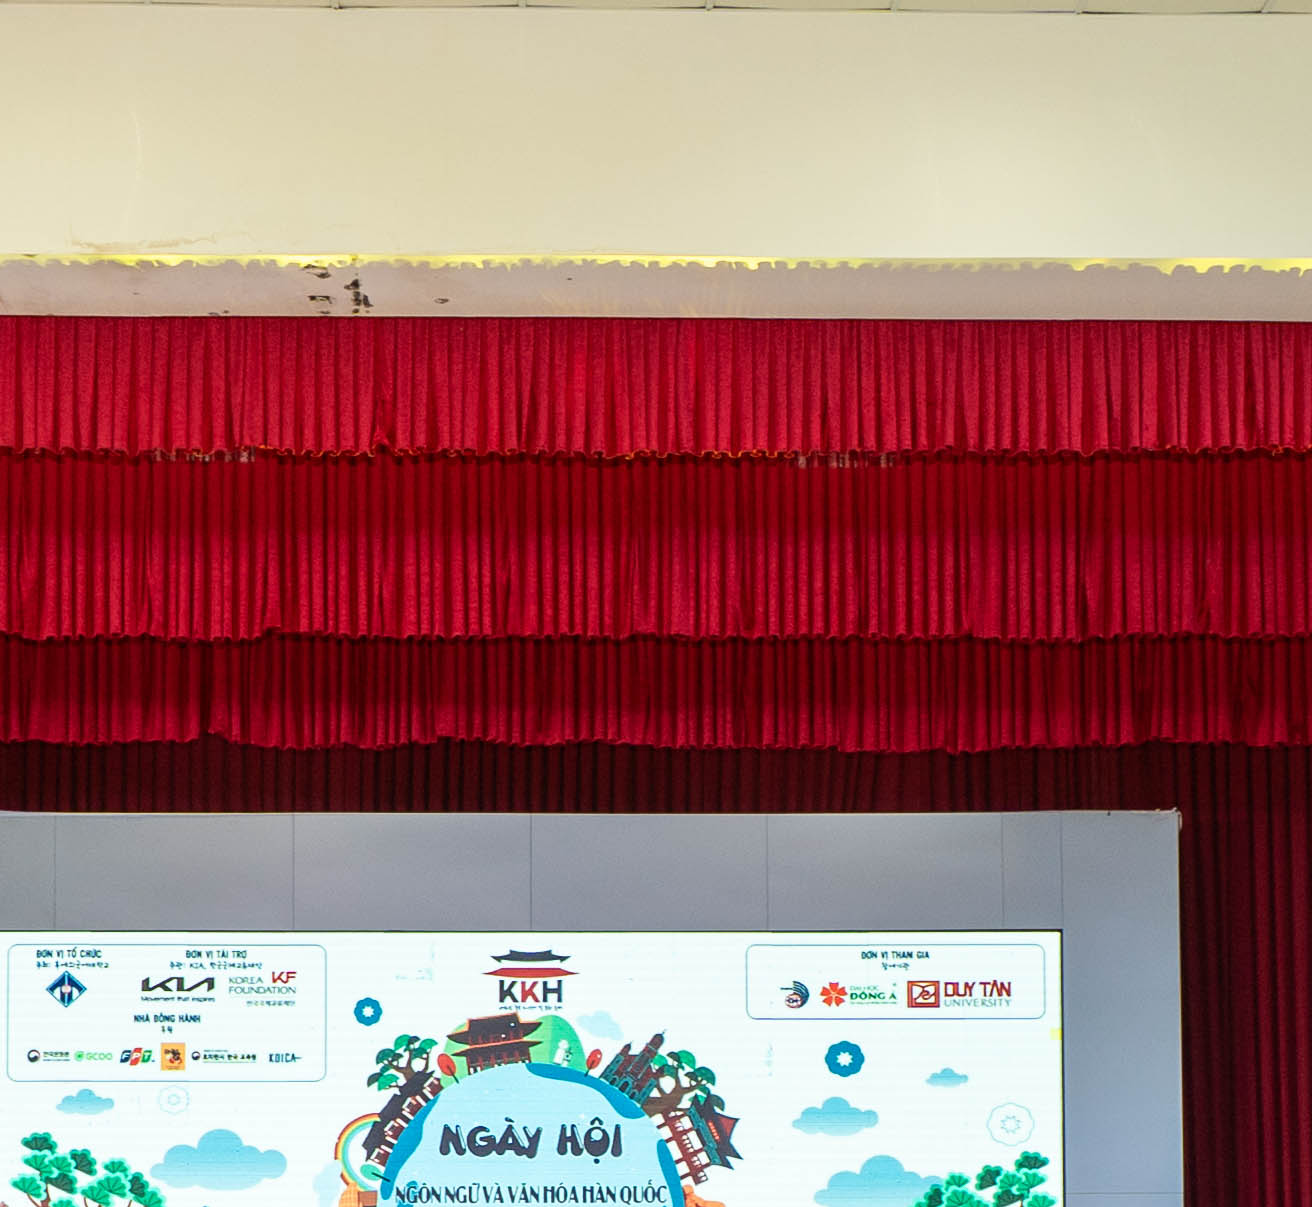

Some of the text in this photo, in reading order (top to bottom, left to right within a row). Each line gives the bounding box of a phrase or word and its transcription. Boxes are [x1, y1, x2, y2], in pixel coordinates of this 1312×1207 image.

[141, 976, 215, 992] KIA
[228, 976, 264, 985] KOREA
[271, 971, 297, 984] KF
[228, 986, 297, 994] FOUNDATION
[499, 979, 563, 1003] KKH
[944, 981, 975, 997] DUY
[944, 998, 1012, 1007] UNIVERSITY
[121, 1049, 152, 1063] FPT
[268, 1053, 297, 1063] KOICA
[439, 1116, 623, 1165] NGÀY HỘI
[395, 1179, 668, 1206] NGÔN NGỮ VÀ VĂN HÓA HÀN QUỐC
